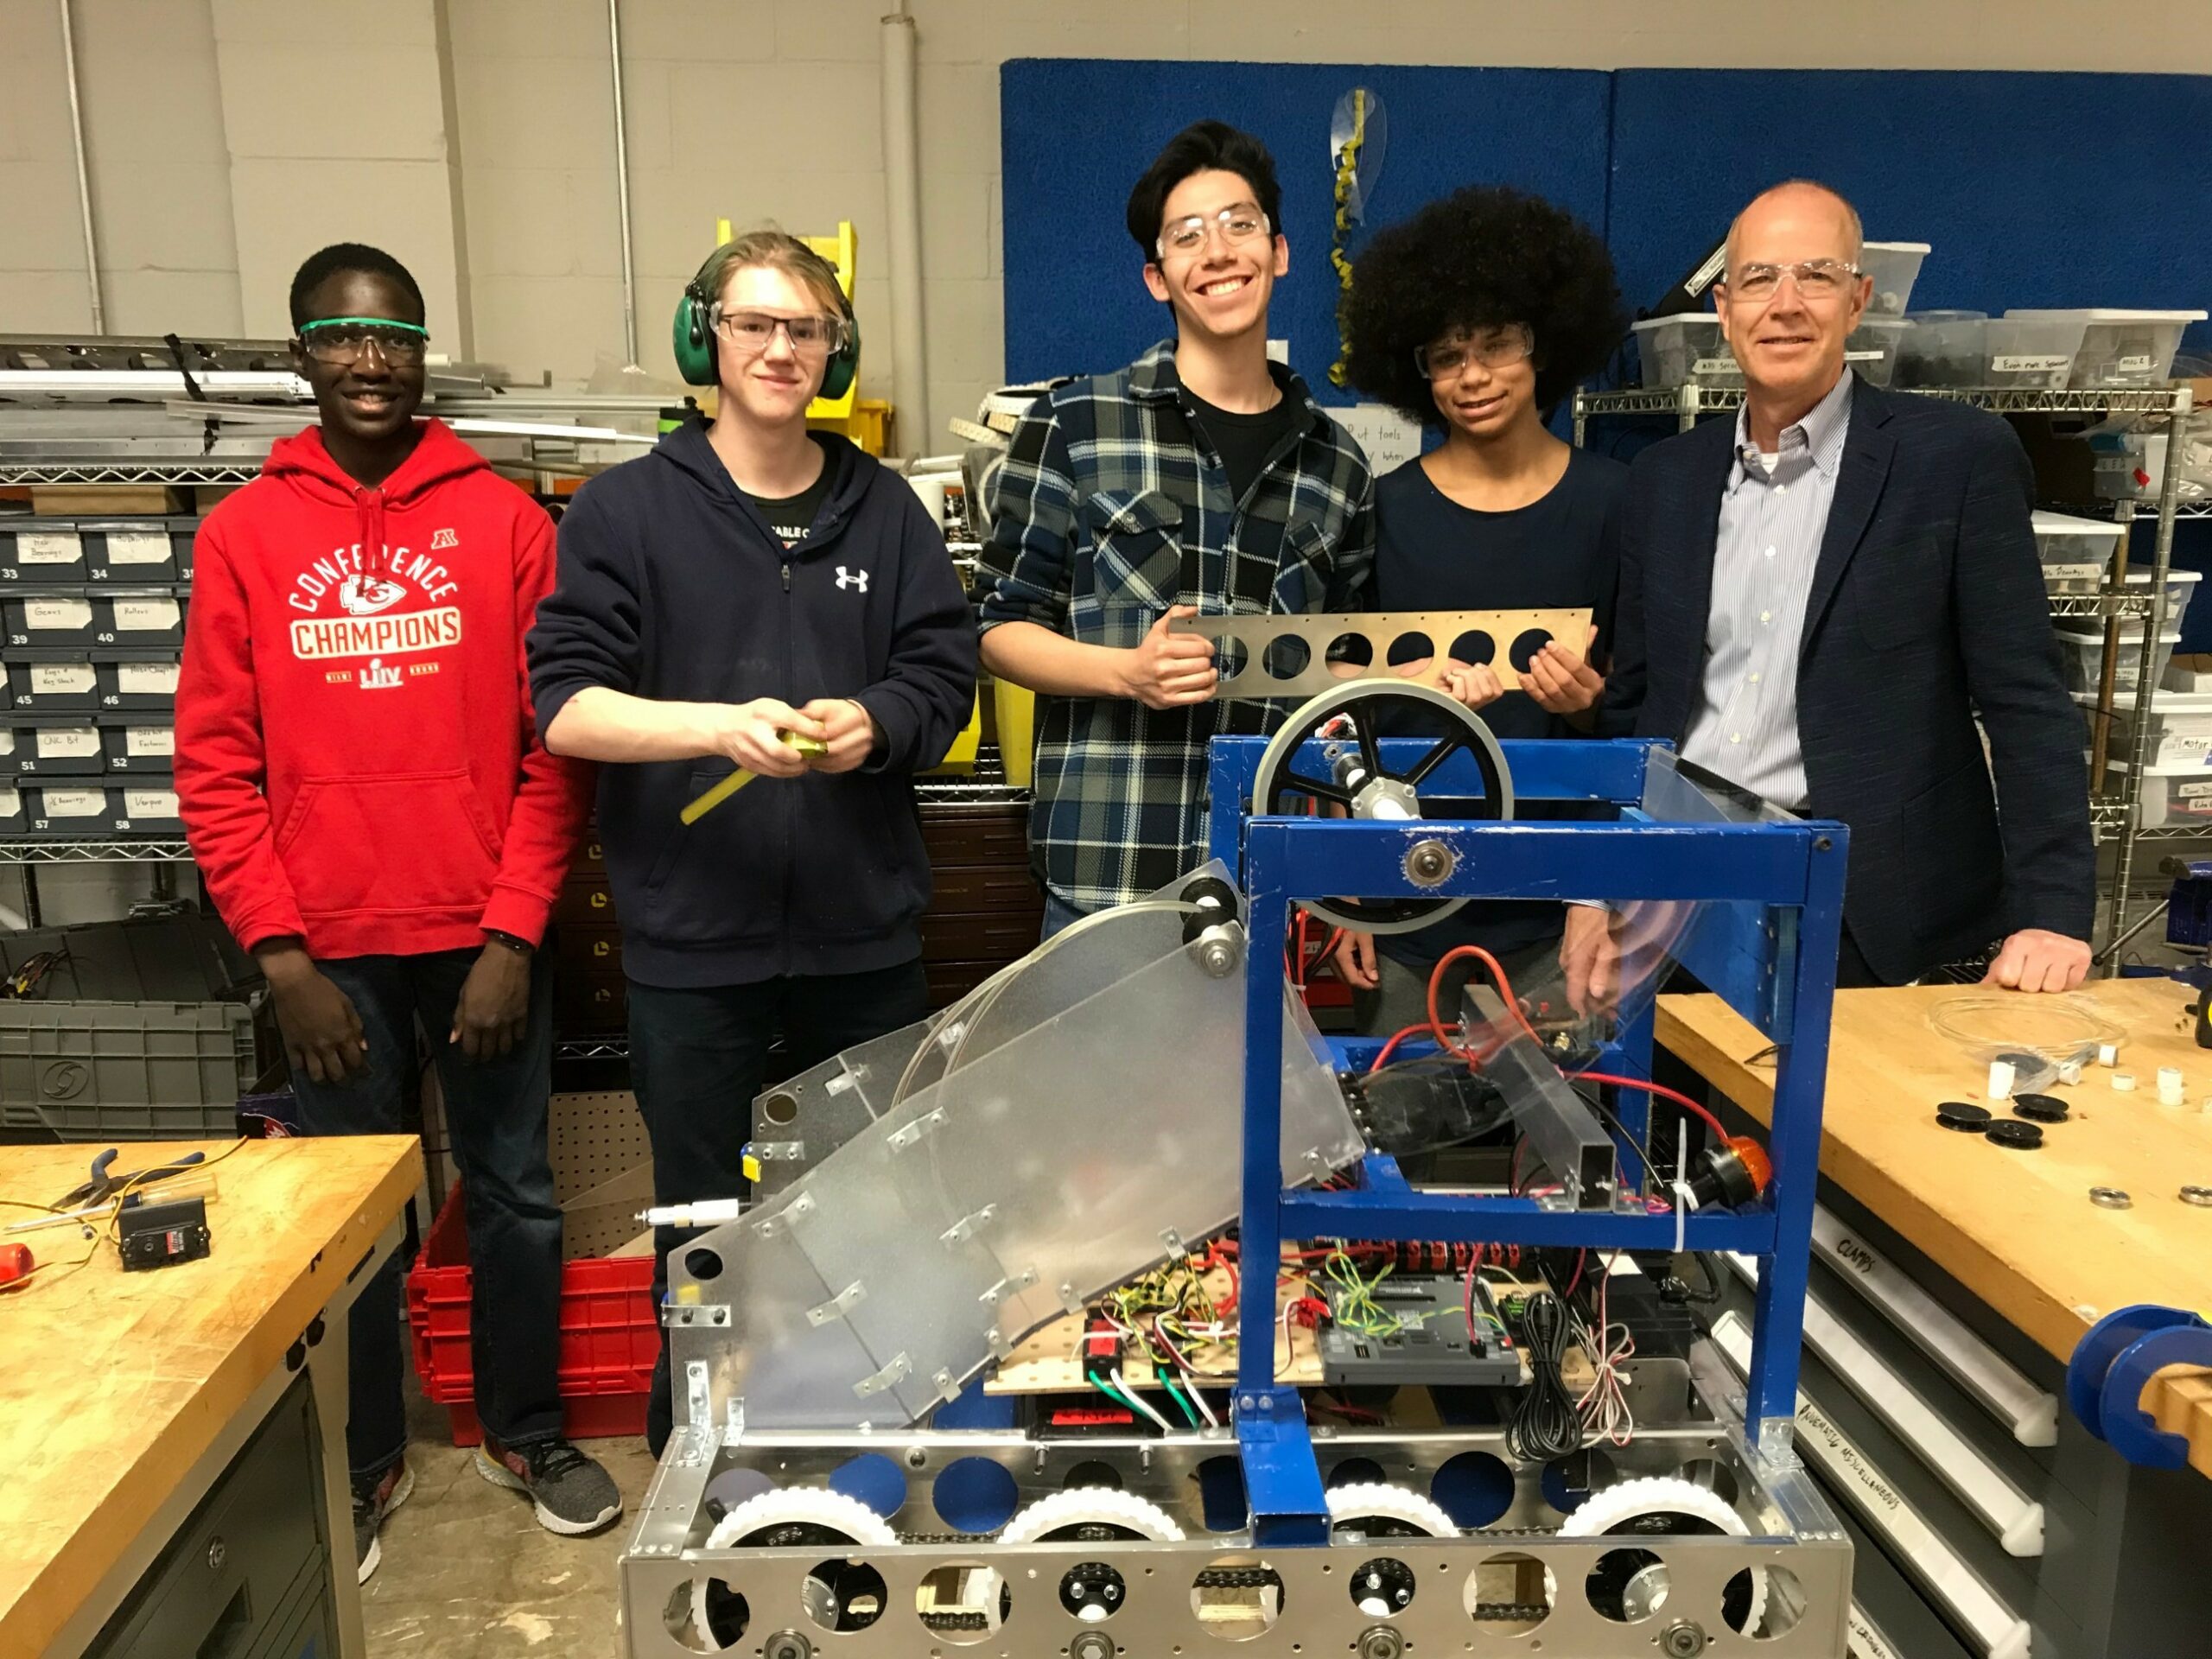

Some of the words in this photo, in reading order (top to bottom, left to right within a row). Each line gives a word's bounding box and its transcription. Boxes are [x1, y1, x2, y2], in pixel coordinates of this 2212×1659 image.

[1379, 426, 1402, 441] tools
[1382, 451, 1405, 462] when
[1, 568, 18, 580] 33
[92, 569, 108, 580] 34
[34, 607, 61, 616] Gears
[124, 607, 149, 615] Rollers
[98, 632, 114, 643] 40
[295, 610, 459, 655] CHAMPIONS
[12, 634, 29, 645] 39
[16, 695, 33, 705] 45
[103, 695, 119, 705] 46
[44, 736, 63, 746] CNC
[2183, 739, 2209, 749] Motor
[22, 760, 35, 771] 51
[112, 758, 128, 768] 52
[35, 820, 49, 830] 57
[115, 820, 130, 830] 58
[1836, 1238, 1876, 1274] CLAMPS
